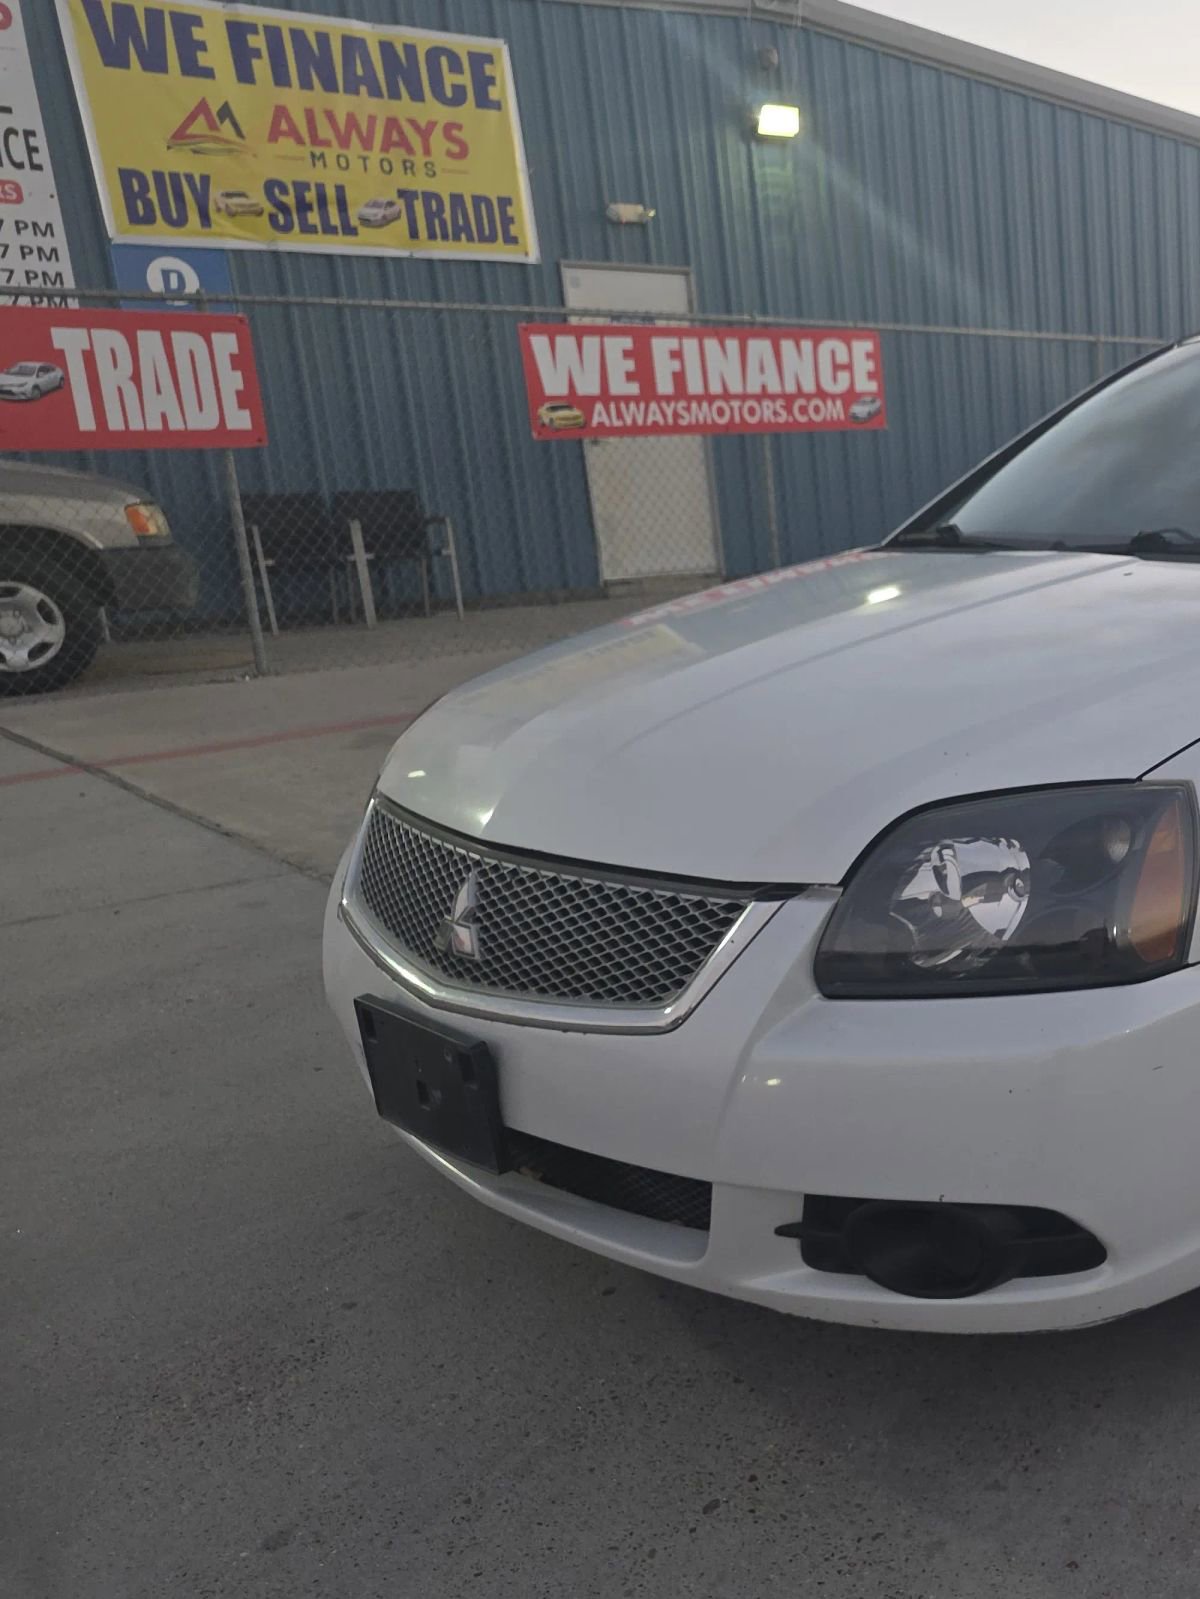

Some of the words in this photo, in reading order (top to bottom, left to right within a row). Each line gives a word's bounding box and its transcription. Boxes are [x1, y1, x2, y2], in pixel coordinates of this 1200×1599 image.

[82, 0, 216, 80] WE
[225, 19, 503, 111] FINANCE
[0, 126, 44, 171] CE
[267, 105, 470, 161] ALWAYS
[311, 151, 438, 178] MOTORS
[14, 219, 55, 238] PM
[118, 167, 215, 230] BUY
[263, 178, 359, 237] SELL
[397, 188, 520, 246] TRADE
[19, 244, 60, 262] PM
[0, 268, 15, 284] 7
[24, 269, 65, 288] PM
[50, 327, 253, 433] TRADE
[529, 334, 641, 397] WE
[650, 336, 879, 396] FINANCE
[591, 398, 845, 428] ALWAYSMOTORS.COM
